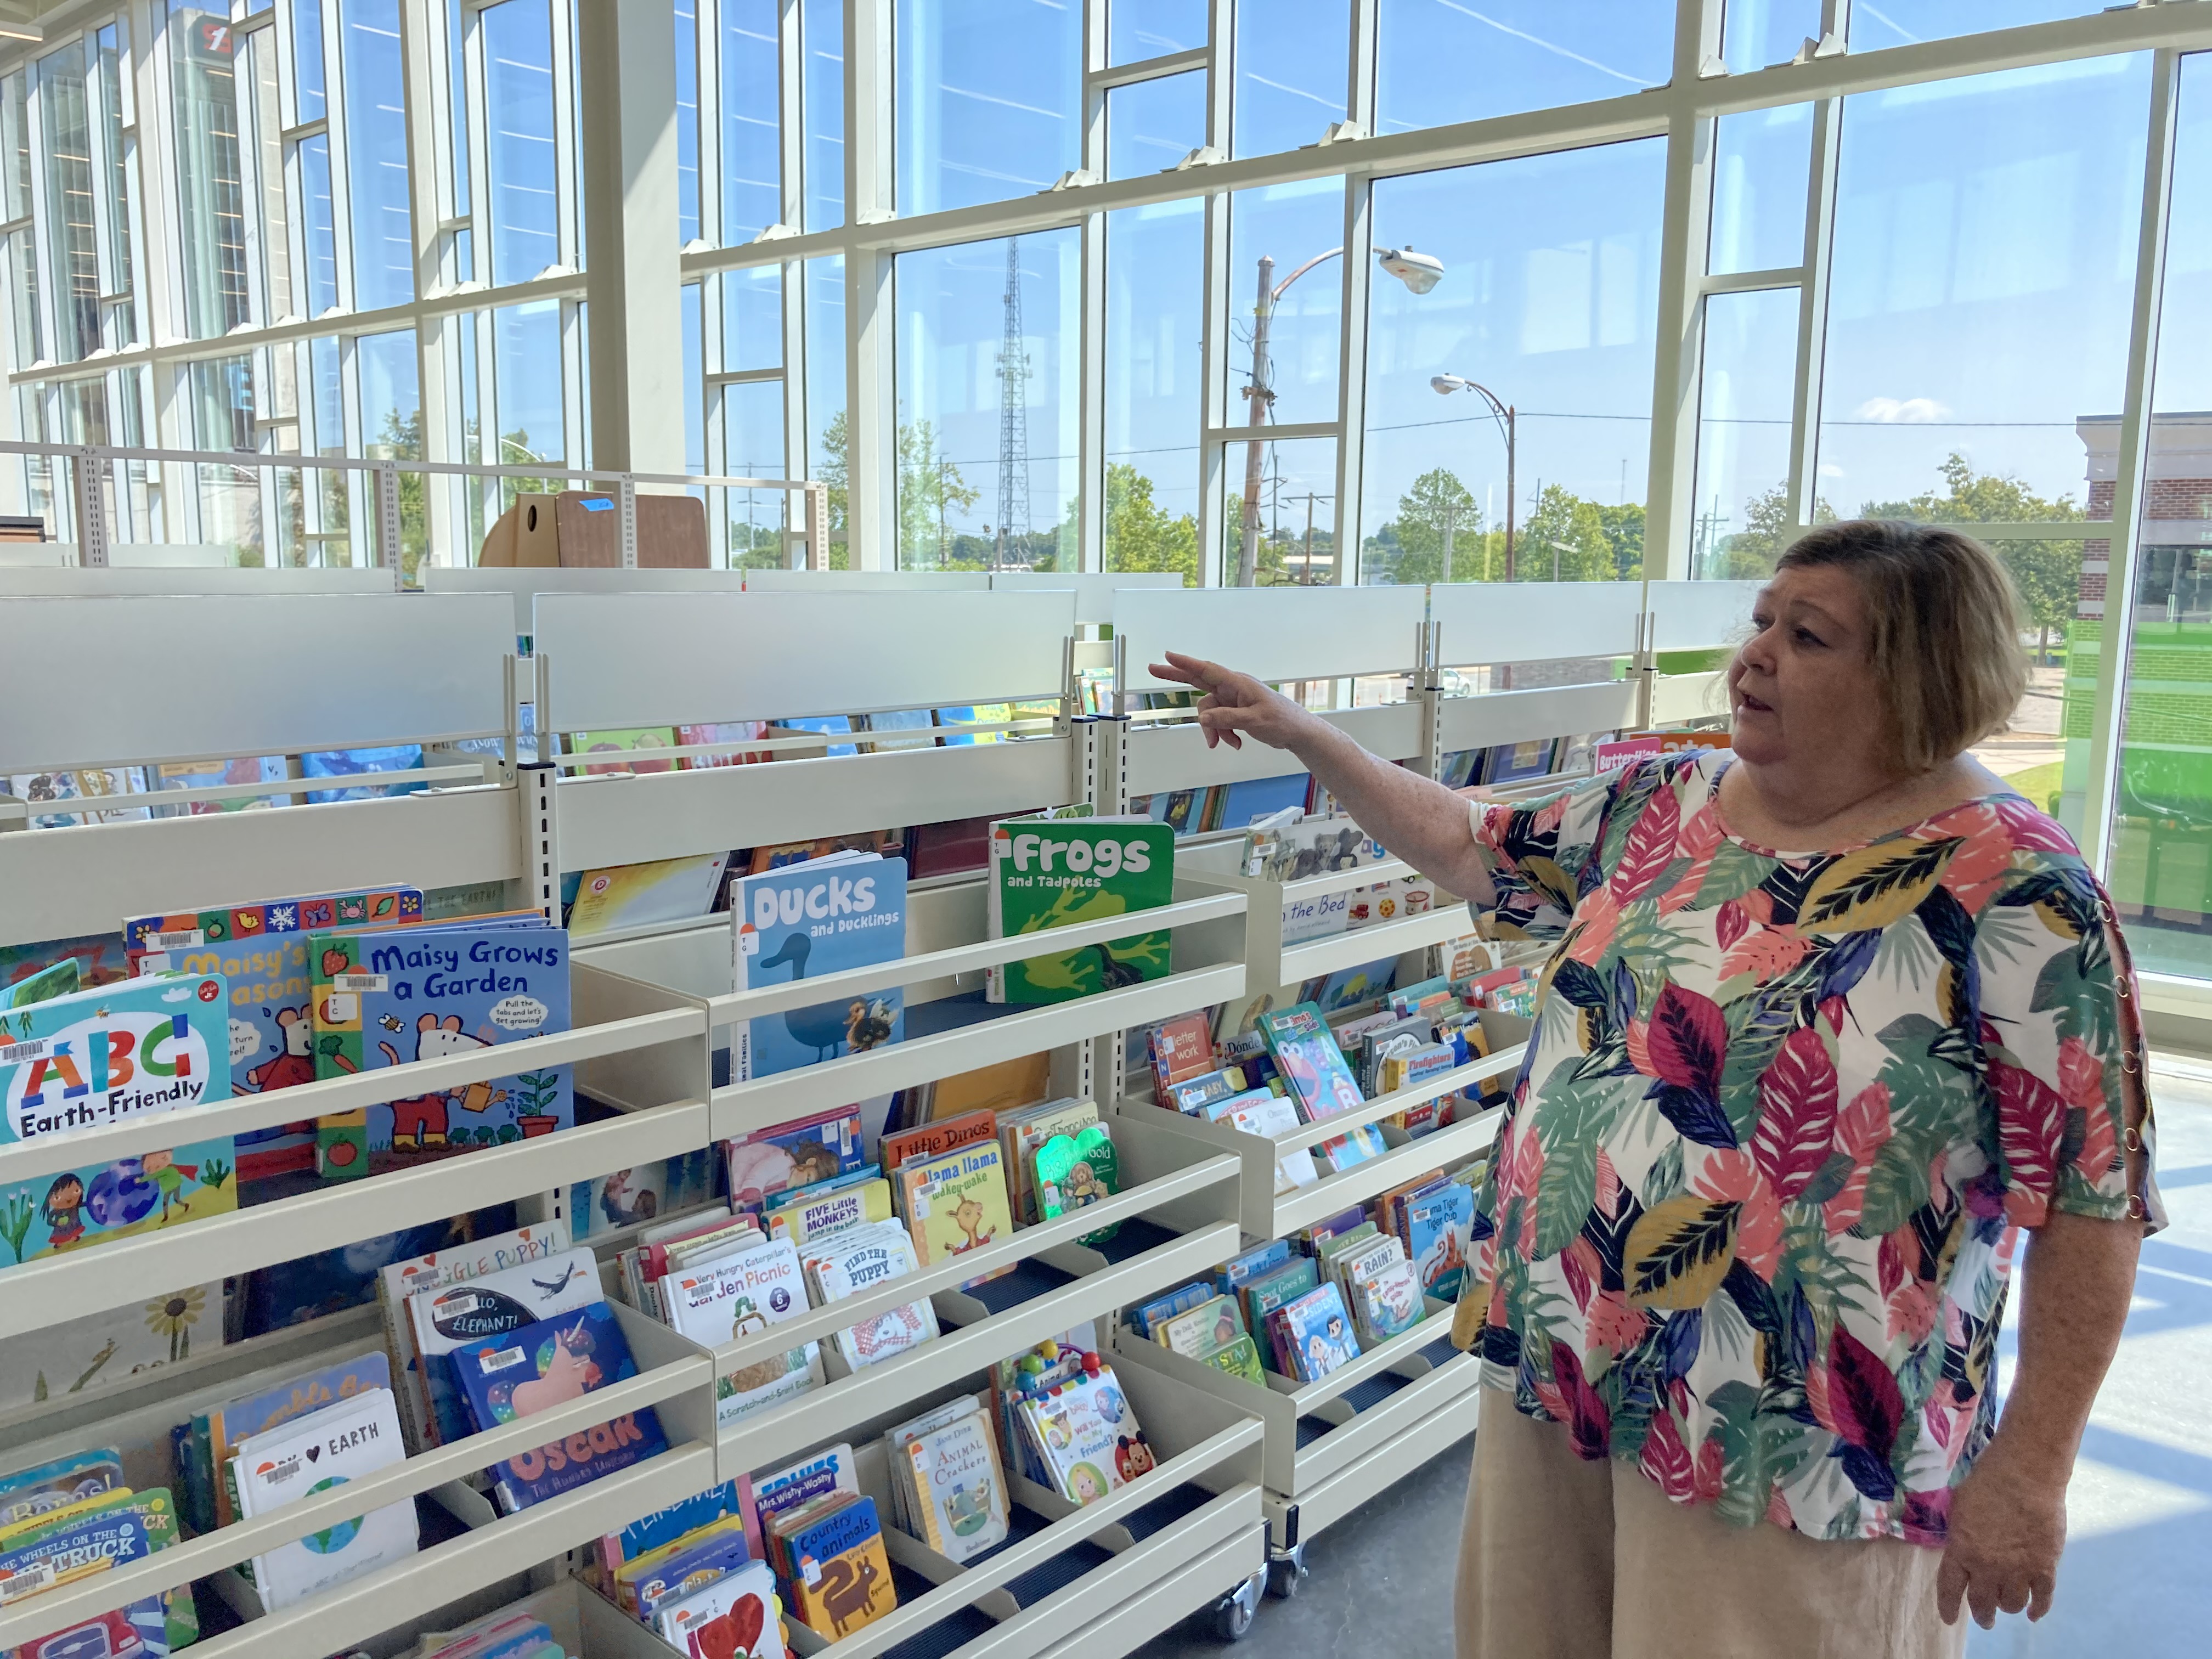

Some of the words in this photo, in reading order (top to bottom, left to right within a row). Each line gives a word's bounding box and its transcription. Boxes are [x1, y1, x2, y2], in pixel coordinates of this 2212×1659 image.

[1013, 834, 1150, 878] Frogs
[1008, 876, 1032, 887] and
[1037, 876, 1102, 889] Tadpoles
[1291, 902, 1314, 920] the
[1318, 893, 1347, 916] Bed
[810, 922, 834, 938] and
[838, 911, 899, 932] Ducklings
[371, 943, 459, 973] Maisy
[469, 940, 559, 967] Grows
[394, 981, 412, 1000] a
[424, 968, 528, 998] Garden
[510, 1015, 541, 1026] growing!
[1304, 1020, 1319, 1032] Slide
[235, 1035, 253, 1043] turn
[1173, 1031, 1197, 1047] letter
[1176, 1044, 1200, 1060] work
[20, 1013, 191, 1109] ABC
[1409, 1050, 1454, 1070] Firefighters!
[20, 1081, 204, 1138] Earth-Friendly
[944, 1121, 990, 1148] Dinos
[1089, 1146, 1110, 1159] Gold
[928, 1164, 960, 1182] lama
[962, 1152, 998, 1174] llama
[805, 1203, 830, 1221] FIVE
[833, 1197, 857, 1211] Little
[1442, 1197, 1459, 1210] Tiger
[807, 1205, 859, 1232] MONKEYS
[808, 1228, 825, 1242] jump
[834, 1222, 844, 1231] the
[845, 1216, 860, 1228] bath
[1426, 1217, 1443, 1231] Tiger
[1444, 1212, 1457, 1223] Cub
[495, 1232, 558, 1270] PUPPY!
[844, 1251, 866, 1272] FIND
[867, 1249, 887, 1259] THE
[1364, 1249, 1392, 1275] RAIN?
[696, 1273, 715, 1286] Very
[716, 1264, 744, 1277] Hungry
[745, 1246, 792, 1268] Caterpillar's
[745, 1262, 791, 1289] Picnic
[849, 1260, 890, 1286] PUPPY
[1279, 1278, 1298, 1294] Goes
[1299, 1274, 1307, 1285] to
[776, 1294, 783, 1305] 6
[453, 1315, 518, 1333] ELEPHANT!
[1040, 1370, 1062, 1387] Animal
[719, 1412, 726, 1421] A
[1075, 1421, 1089, 1435] Will
[329, 1422, 379, 1455] EARTH
[1080, 1434, 1114, 1458] Friend?
[935, 1455, 987, 1486] Crackers
[777, 1472, 832, 1504] Wishy-Washy
[127, 1504, 149, 1514] THE
[142, 1515, 170, 1530] CK
[800, 1513, 852, 1552] Country
[1, 1559, 16, 1571] HE
[19, 1539, 69, 1564] WHEELS
[72, 1535, 89, 1547] ON
[92, 1529, 117, 1539] THE
[822, 1516, 871, 1559] animals
[51, 1537, 136, 1573] TRUCK
